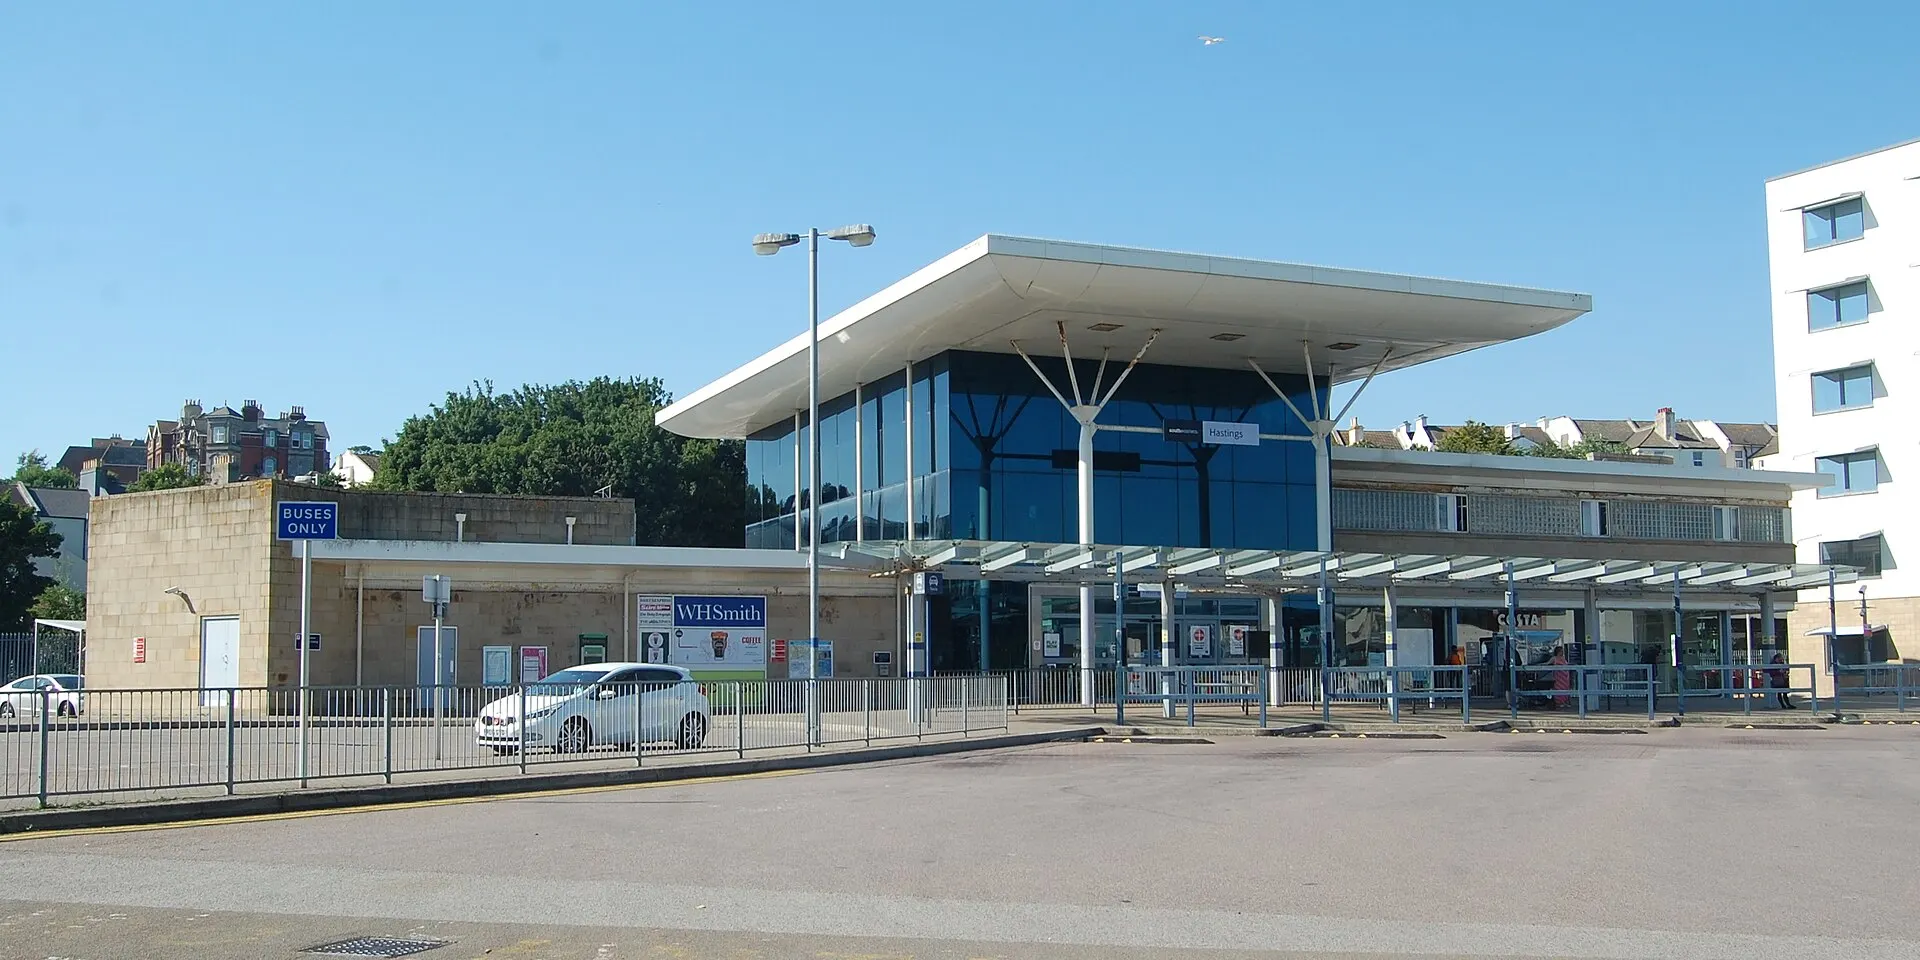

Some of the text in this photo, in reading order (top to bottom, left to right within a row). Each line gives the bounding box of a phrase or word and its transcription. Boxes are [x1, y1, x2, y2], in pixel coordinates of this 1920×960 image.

[1209, 428, 1244, 440] Hastings
[283, 508, 332, 520] BUSES
[288, 523, 327, 534] ONLY
[676, 604, 761, 621] WHSmith
